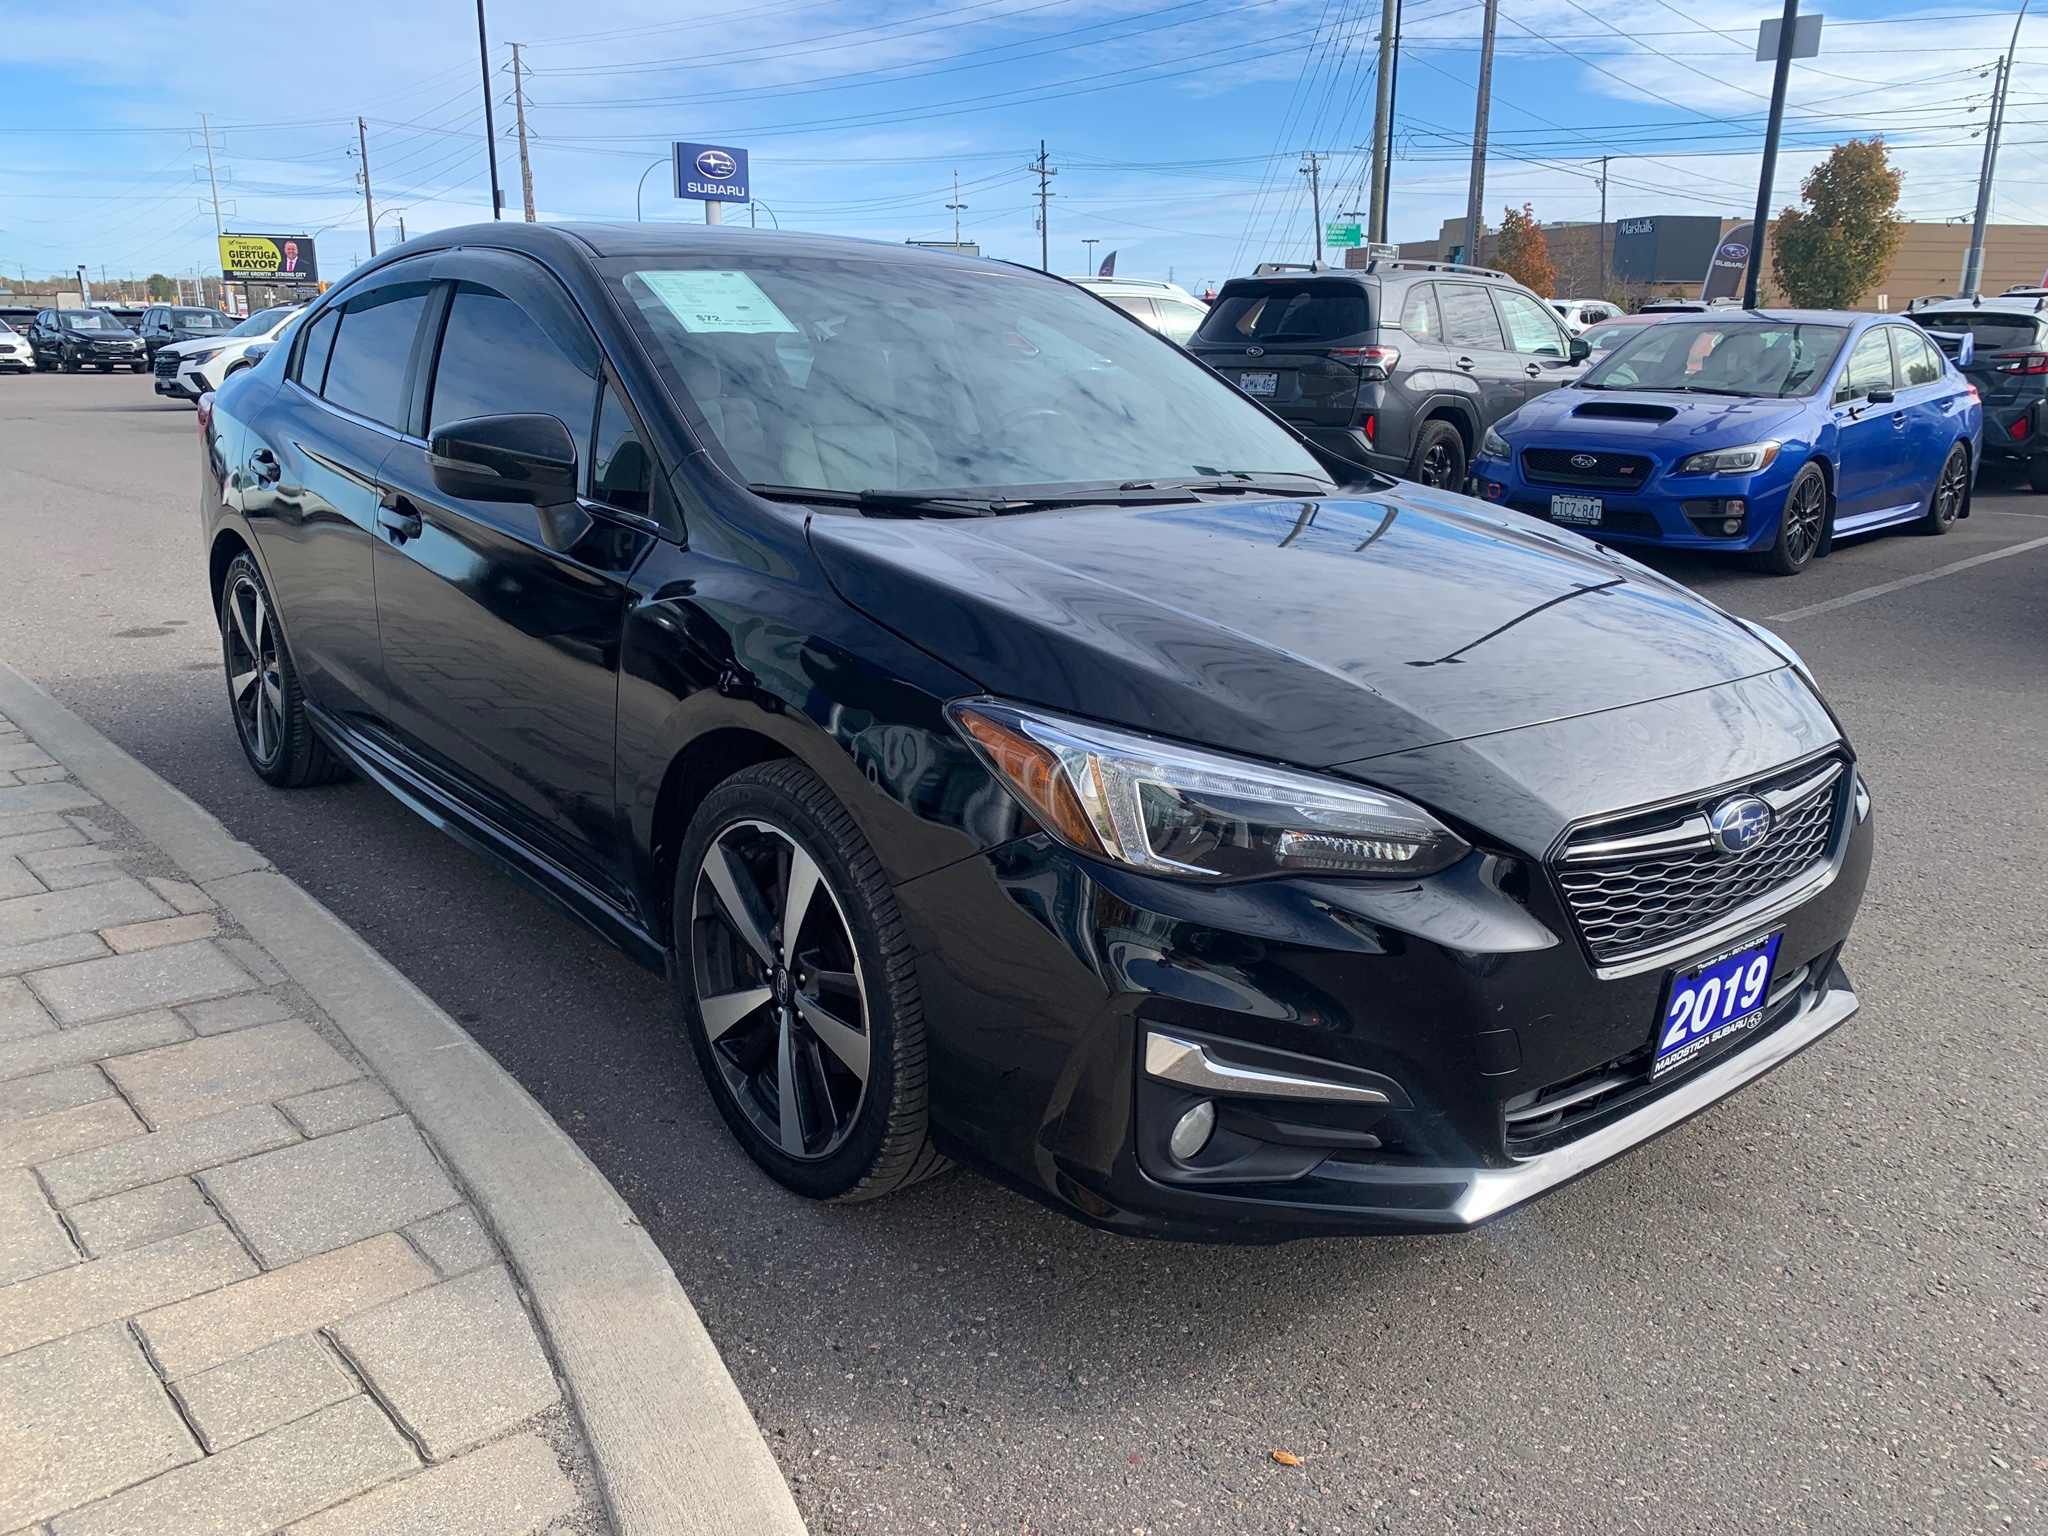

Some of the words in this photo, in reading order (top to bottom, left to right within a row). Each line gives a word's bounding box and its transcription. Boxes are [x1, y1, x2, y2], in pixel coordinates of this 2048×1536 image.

[687, 182, 745, 197] SUBARU
[1619, 219, 1654, 236] Marshalls
[228, 250, 279, 260] GIERTUGA
[231, 259, 277, 269] MAYOR
[1714, 259, 1746, 269] SUBARU
[1661, 955, 1768, 1050] 2019
[1654, 1036, 1710, 1073] MAROSTICA
[1711, 1017, 1748, 1042] SUBARU
